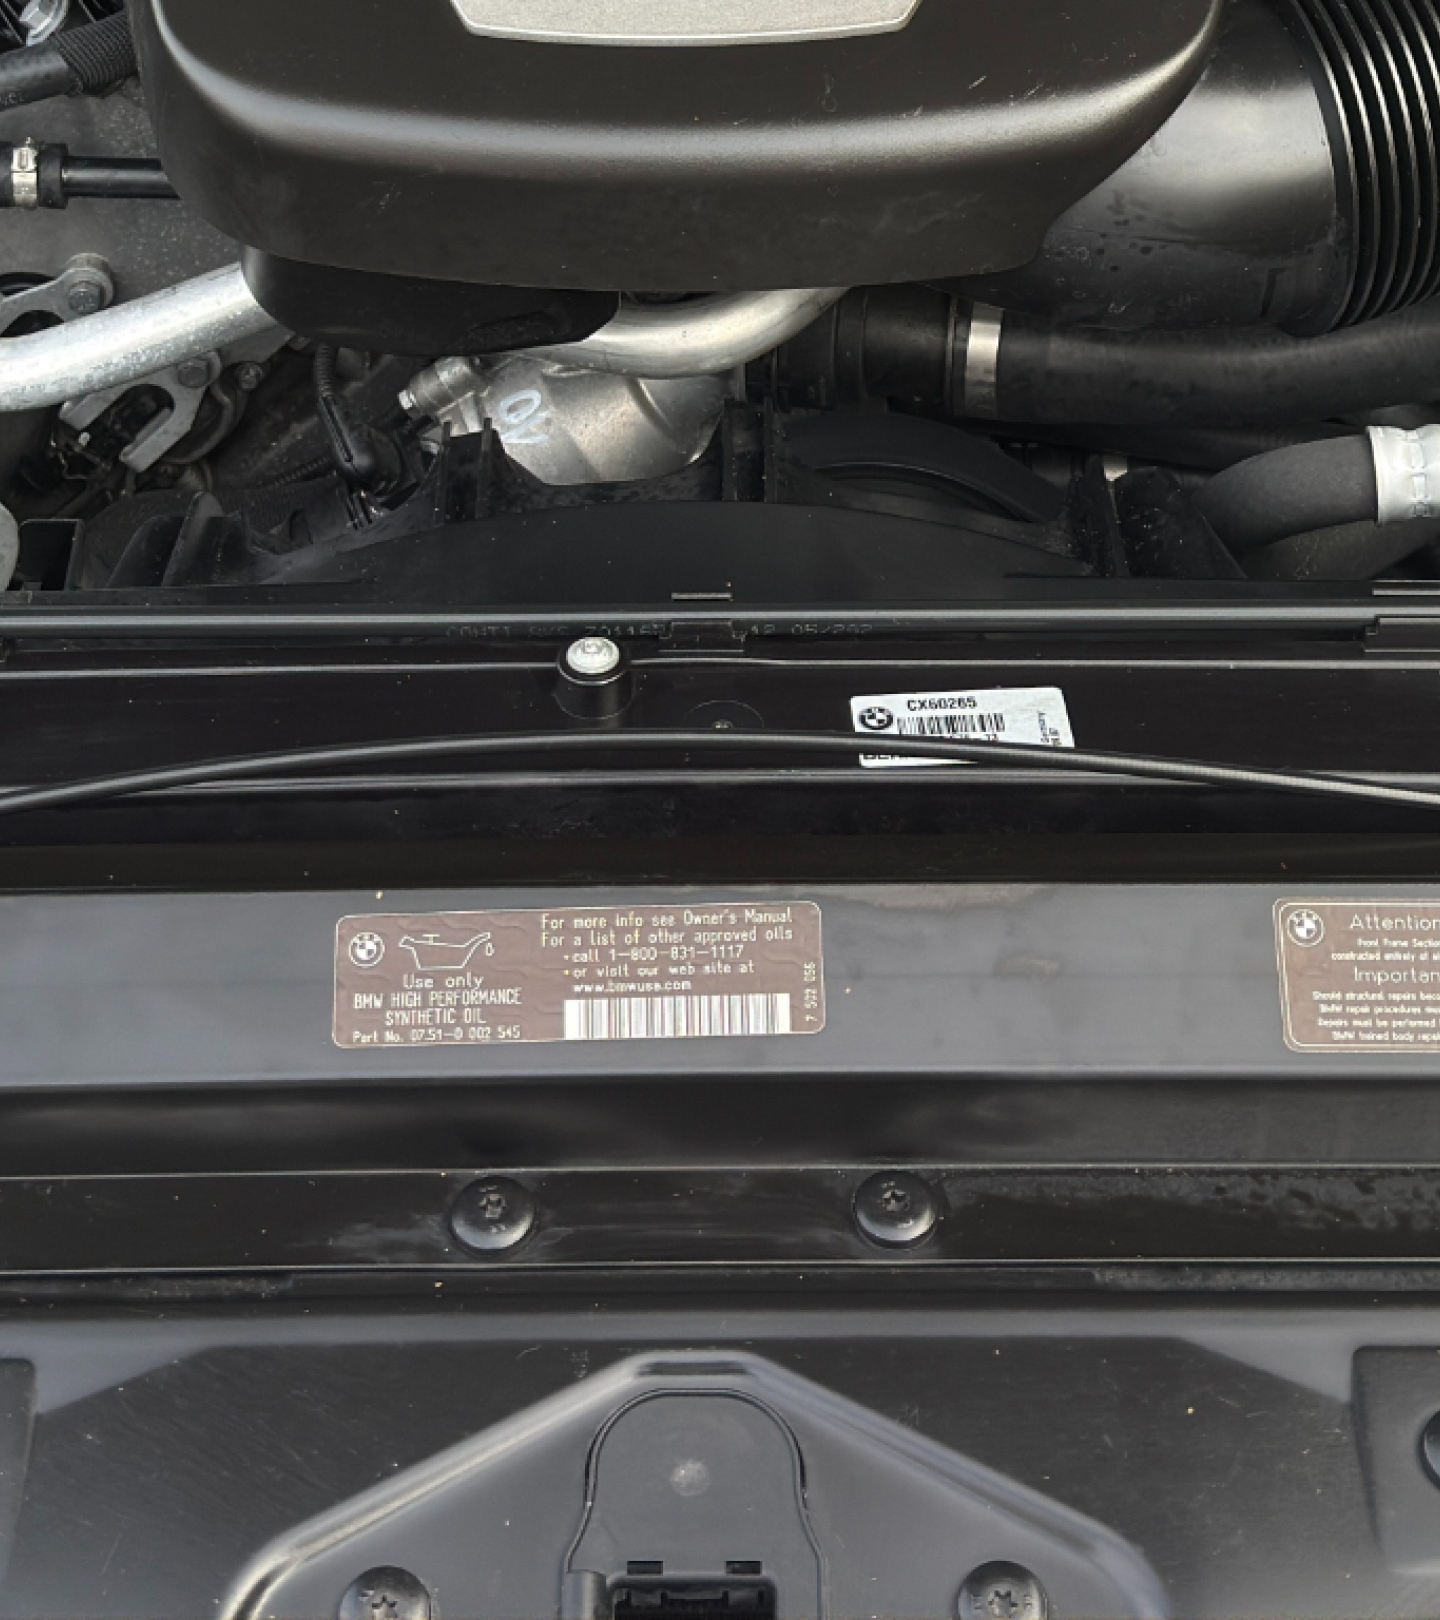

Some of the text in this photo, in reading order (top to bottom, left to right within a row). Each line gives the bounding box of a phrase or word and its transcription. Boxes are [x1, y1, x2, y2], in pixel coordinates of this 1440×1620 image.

[907, 696, 977, 712] CX60265
[541, 908, 792, 929] For more info see Owner's Manual
[541, 926, 792, 948] For a list of other approved oils
[572, 945, 744, 963] call 1-800-831-1117
[572, 960, 755, 978] or visit our web site at
[403, 972, 484, 990] Use only
[354, 987, 522, 1009] BMW HIGH PERFORMANCE
[385, 1008, 486, 1026] SYNTHETIC OIL
[352, 1031, 378, 1043] Part
[384, 1030, 404, 1043] No.
